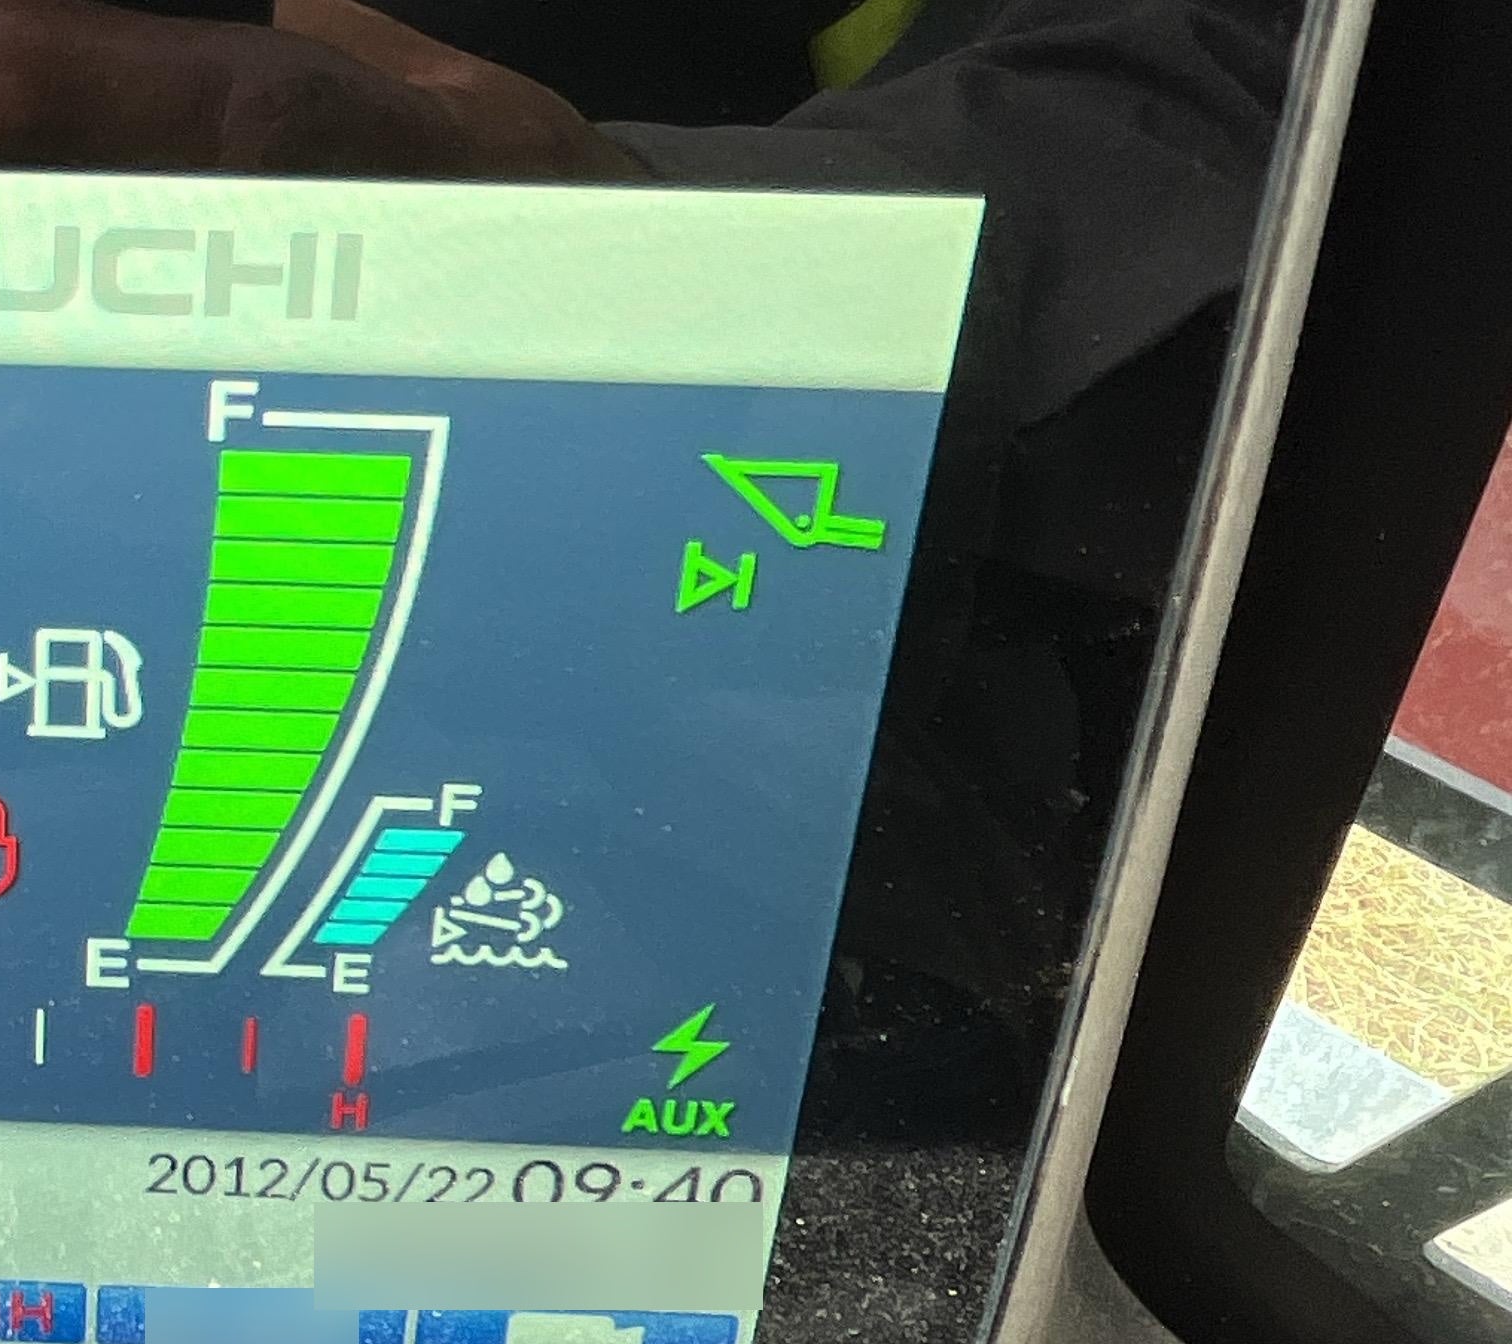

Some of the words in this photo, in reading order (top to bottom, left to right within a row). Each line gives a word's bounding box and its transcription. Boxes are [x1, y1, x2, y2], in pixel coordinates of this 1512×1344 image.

[206, 379, 261, 443] F
[438, 783, 484, 828] F
[84, 936, 131, 989] E
[331, 951, 372, 995] E
[329, 1090, 369, 1130] H
[621, 1096, 736, 1138] AUX
[145, 1151, 496, 1203] 2012/05/22
